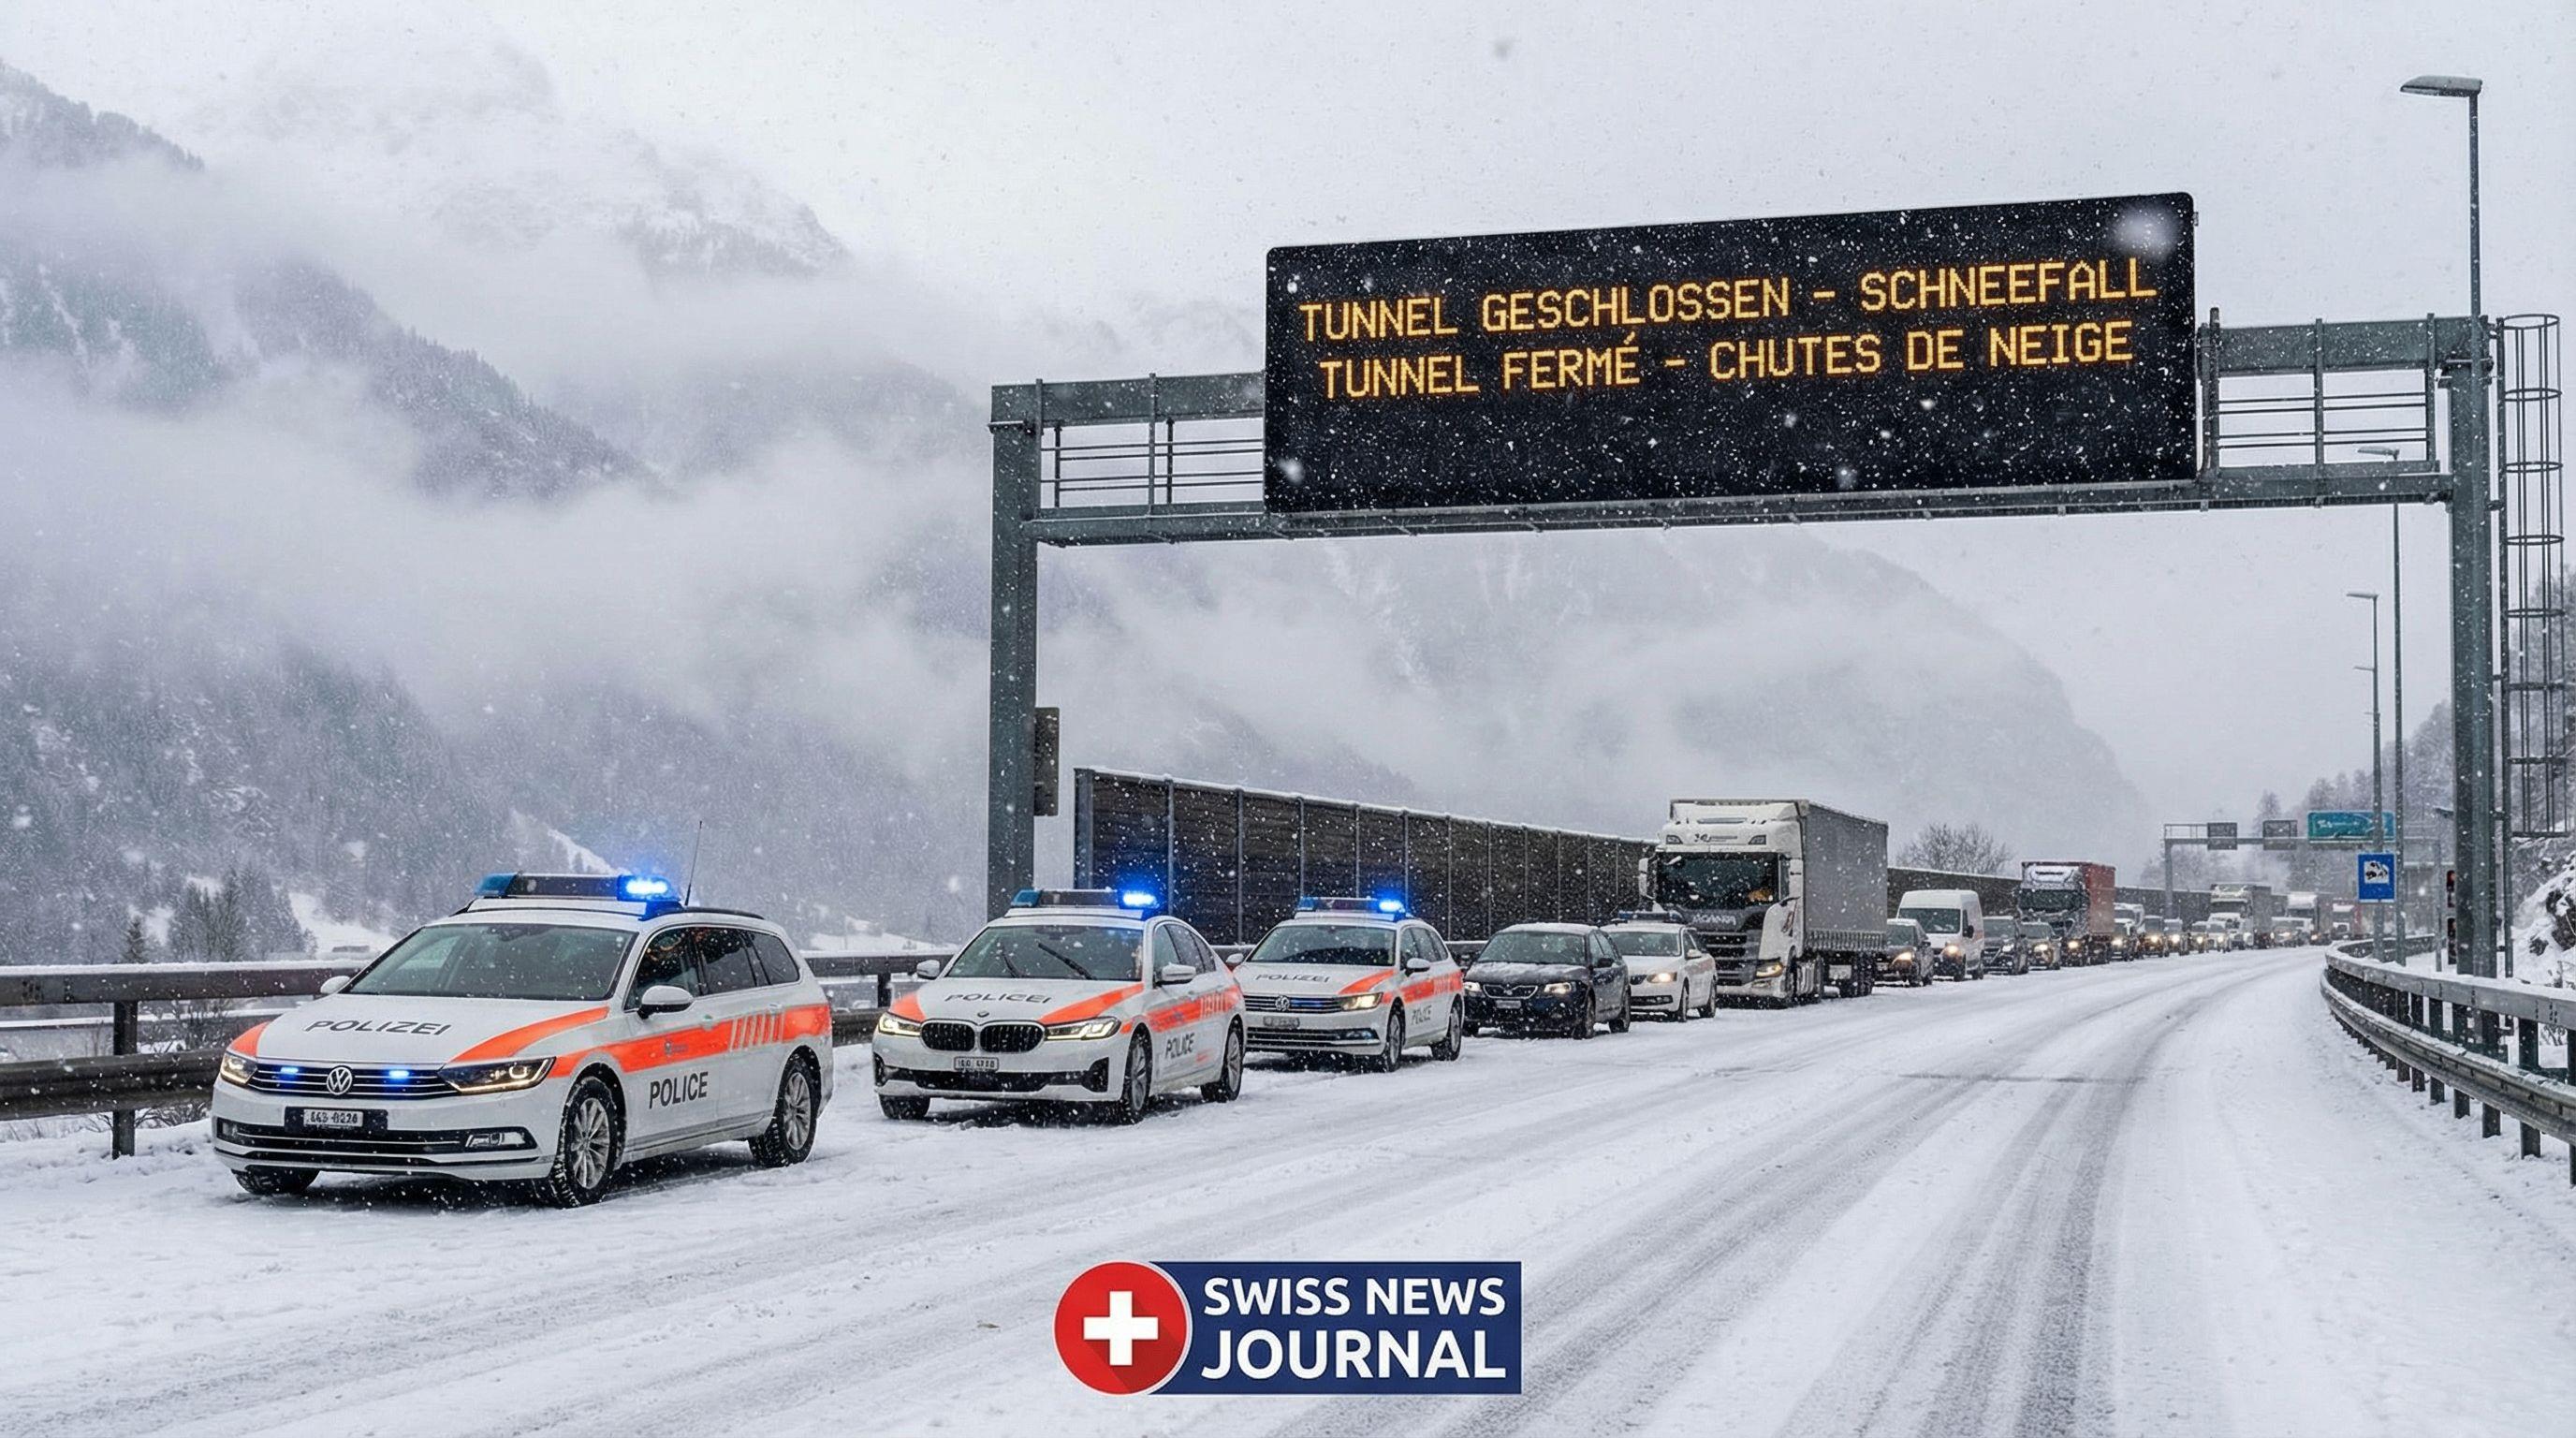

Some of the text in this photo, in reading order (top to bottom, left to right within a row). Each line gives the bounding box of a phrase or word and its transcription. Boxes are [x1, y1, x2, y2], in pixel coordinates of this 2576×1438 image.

[1299, 297, 1457, 341] TUNNEL
[1482, 278, 1789, 332] GESCHLOSSEN
[1861, 257, 2158, 311] SCHNEEFALL
[1319, 355, 1480, 399] TUNNEL
[1503, 331, 1641, 389] FERMÉ
[1710, 333, 1881, 379] CHUTES
[1907, 329, 1964, 371] DE
[1990, 320, 2133, 367] NEIGE
[304, 1020, 451, 1035] POLIZEI
[649, 1071, 709, 1109] POLICE
